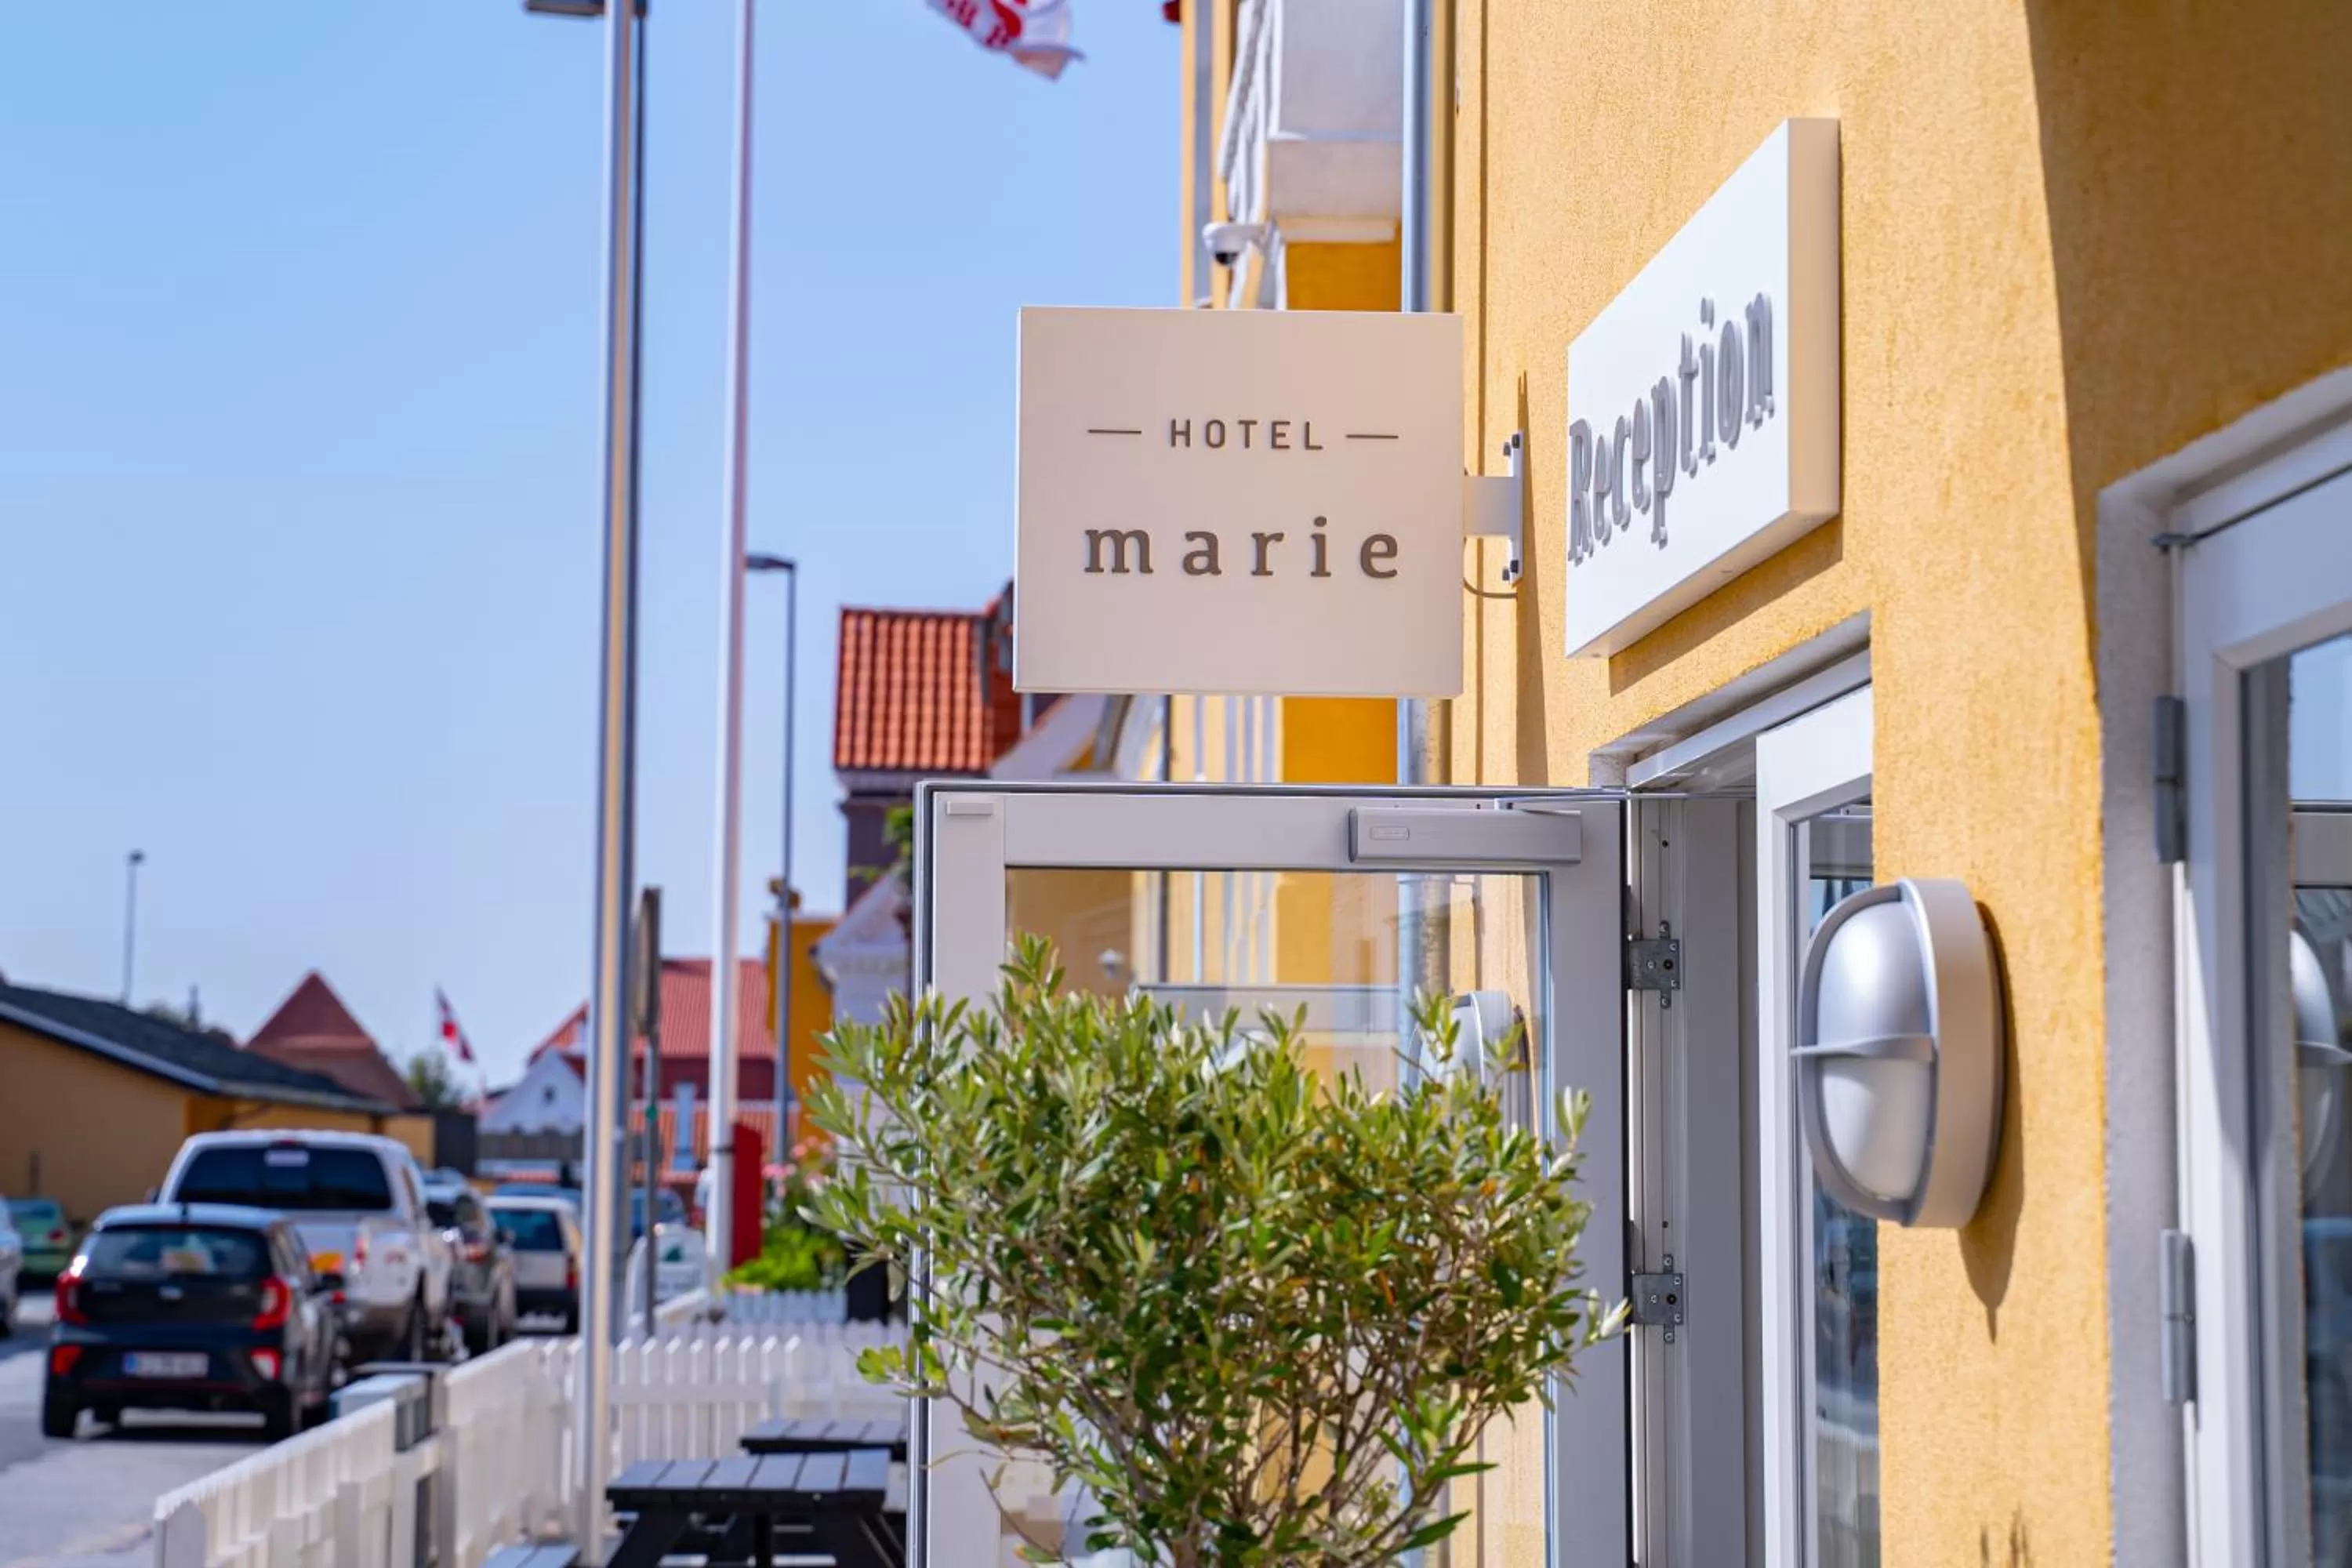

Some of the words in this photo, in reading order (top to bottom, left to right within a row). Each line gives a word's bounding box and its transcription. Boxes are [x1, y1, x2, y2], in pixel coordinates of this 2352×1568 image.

[1170, 418, 1324, 451] HOTEL
[1568, 292, 1775, 567] Reception
[1083, 515, 1399, 579] marie
